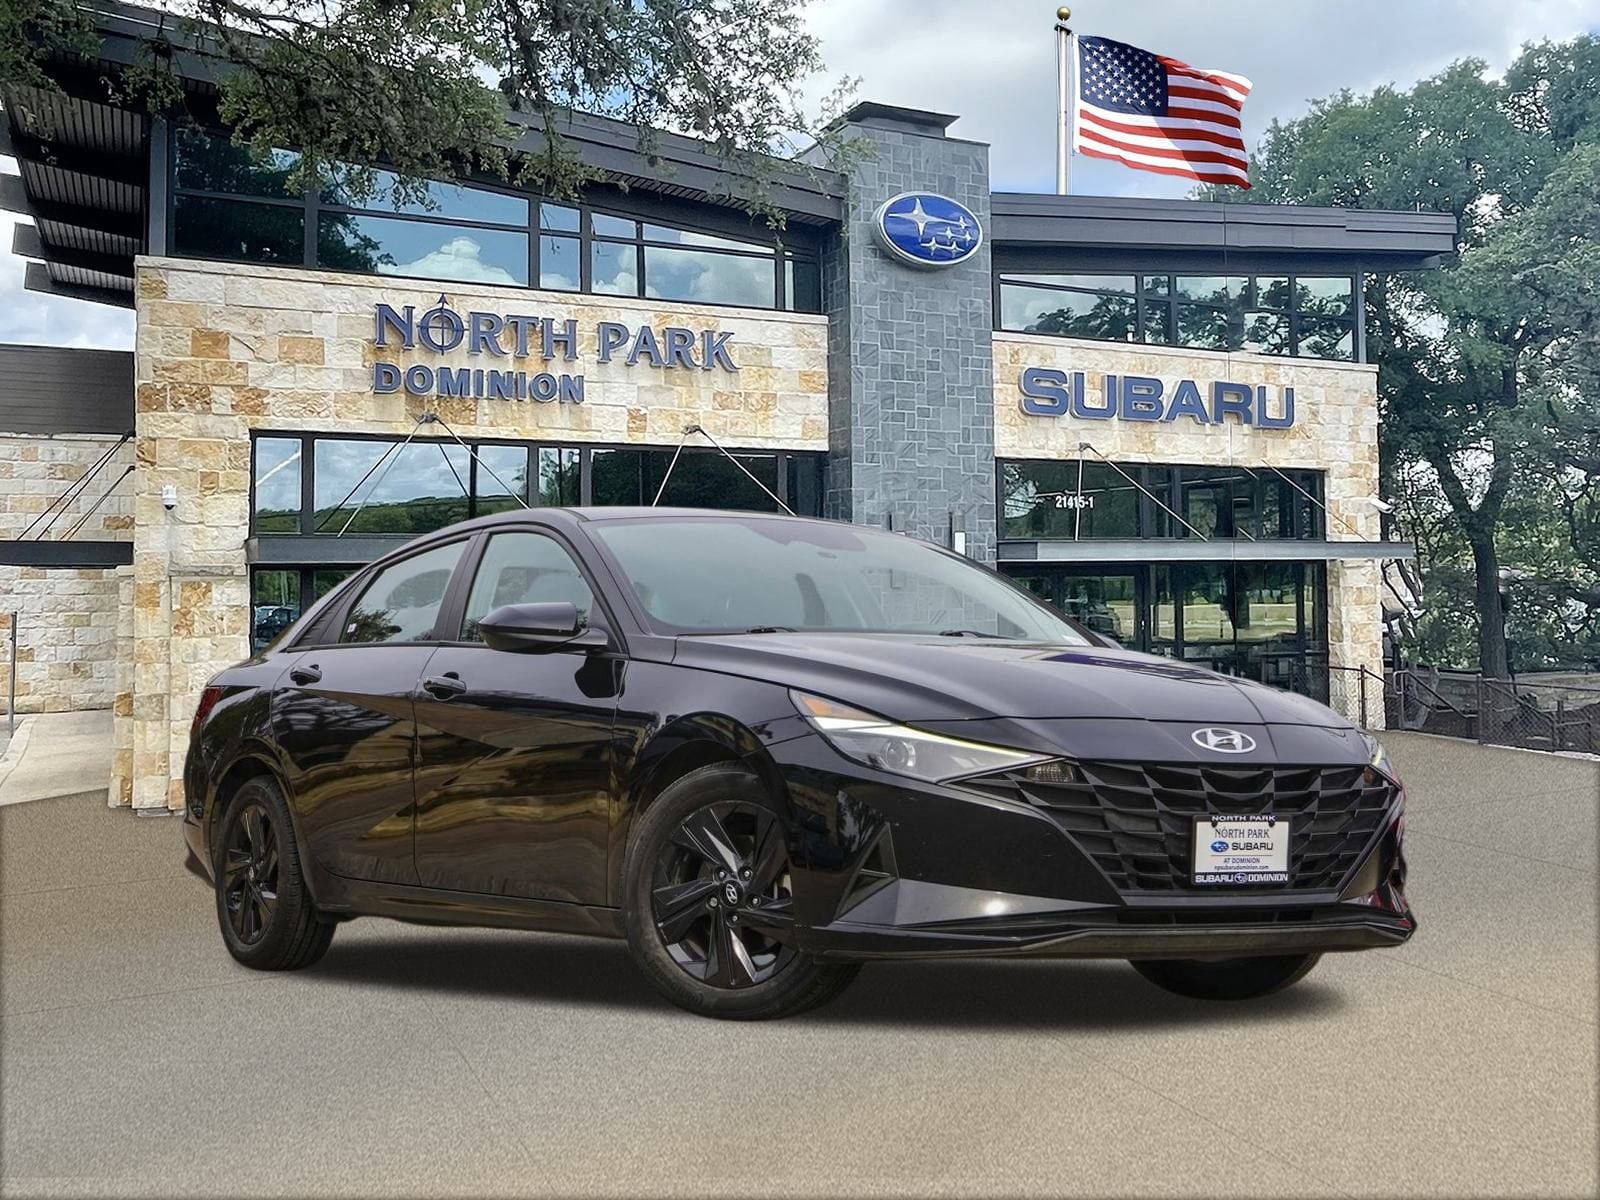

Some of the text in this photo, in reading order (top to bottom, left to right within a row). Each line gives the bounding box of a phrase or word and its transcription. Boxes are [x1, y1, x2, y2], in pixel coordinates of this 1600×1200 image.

[374, 300, 741, 373] NORTH PARK
[373, 361, 585, 404] DOMINION
[1019, 367, 1295, 430] SUBARU
[1214, 828, 1270, 838] NORTH PARK
[1231, 842, 1274, 850] SUBARU
[1195, 873, 1288, 883] SUBARU DOMINION
